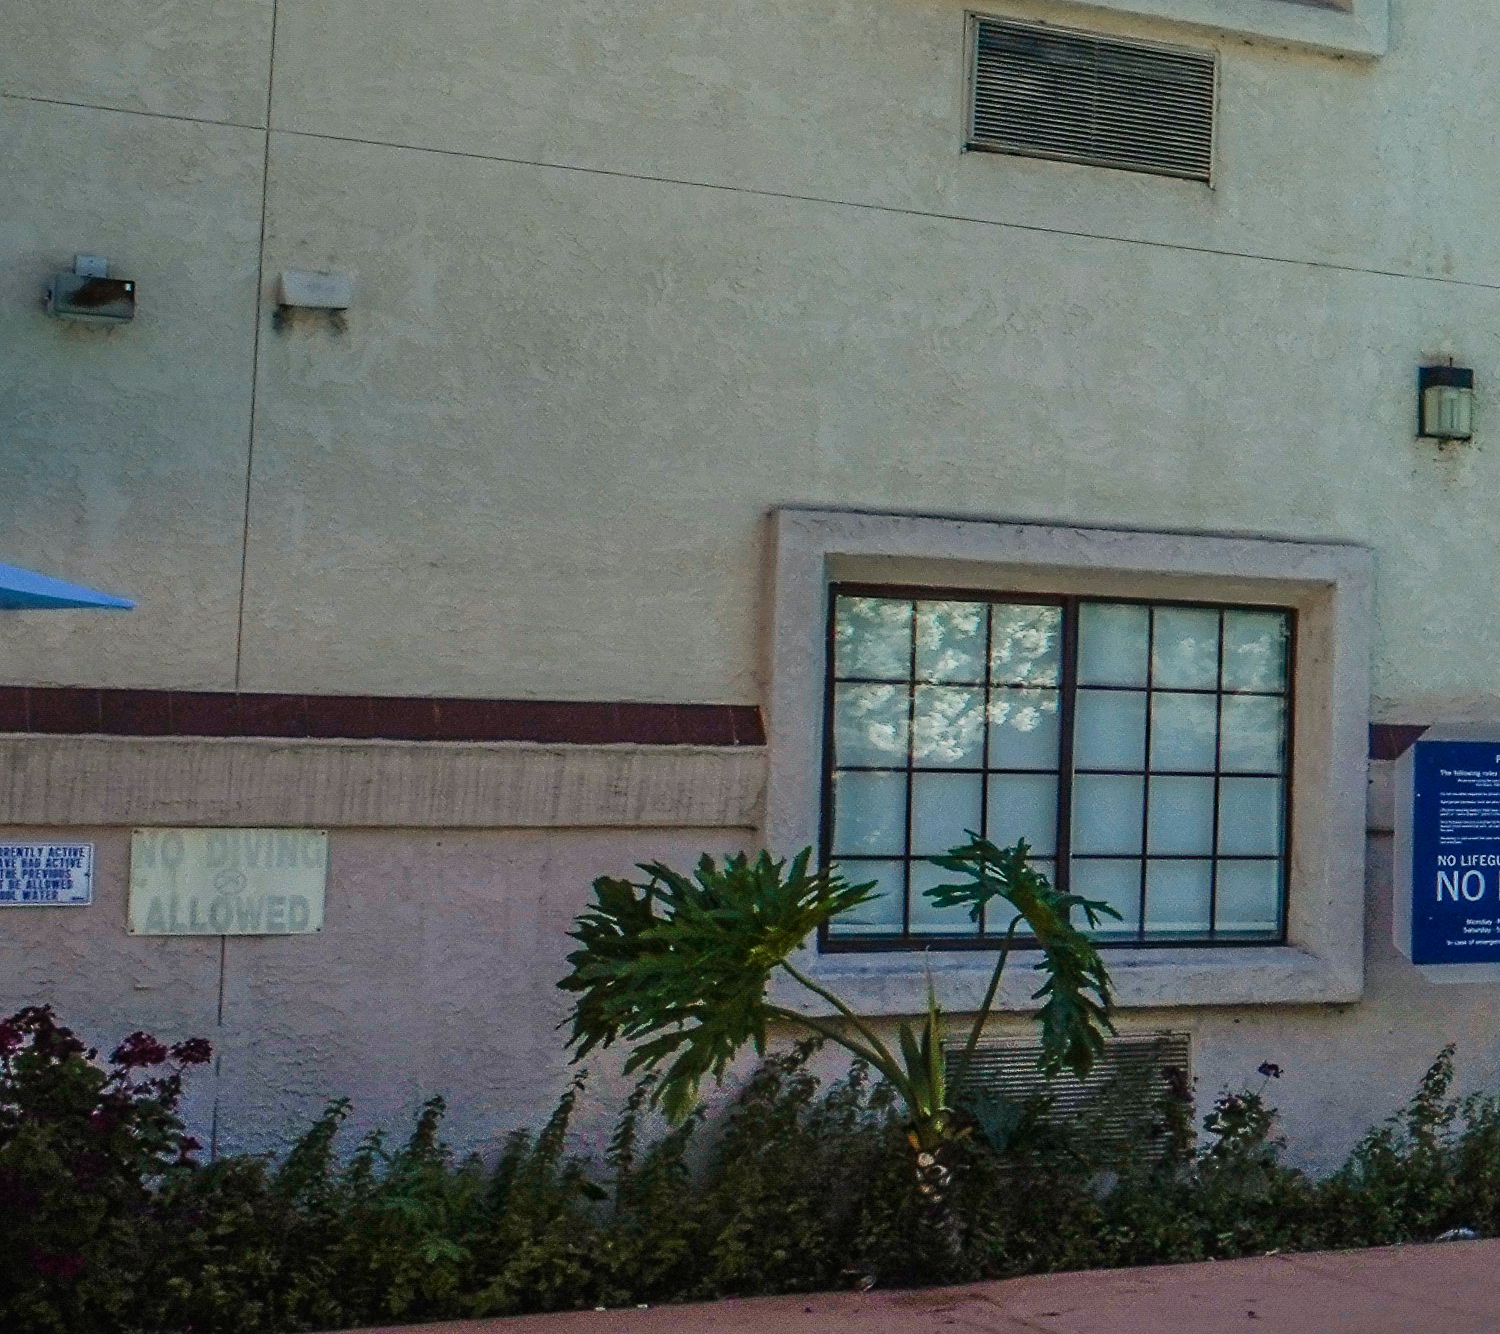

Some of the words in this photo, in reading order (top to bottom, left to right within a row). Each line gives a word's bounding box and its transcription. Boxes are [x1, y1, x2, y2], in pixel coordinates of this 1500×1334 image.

[48, 847, 85, 858] ACTIVE
[21, 858, 41, 868] HAD
[45, 858, 82, 869] ACTIVE
[1437, 855, 1457, 866] NO
[22, 869, 71, 879] PREVIOUS
[26, 879, 74, 890] ALLOWED
[1436, 870, 1486, 902] NO
[22, 890, 58, 901] WATER
[145, 895, 311, 932] ALLOWED
